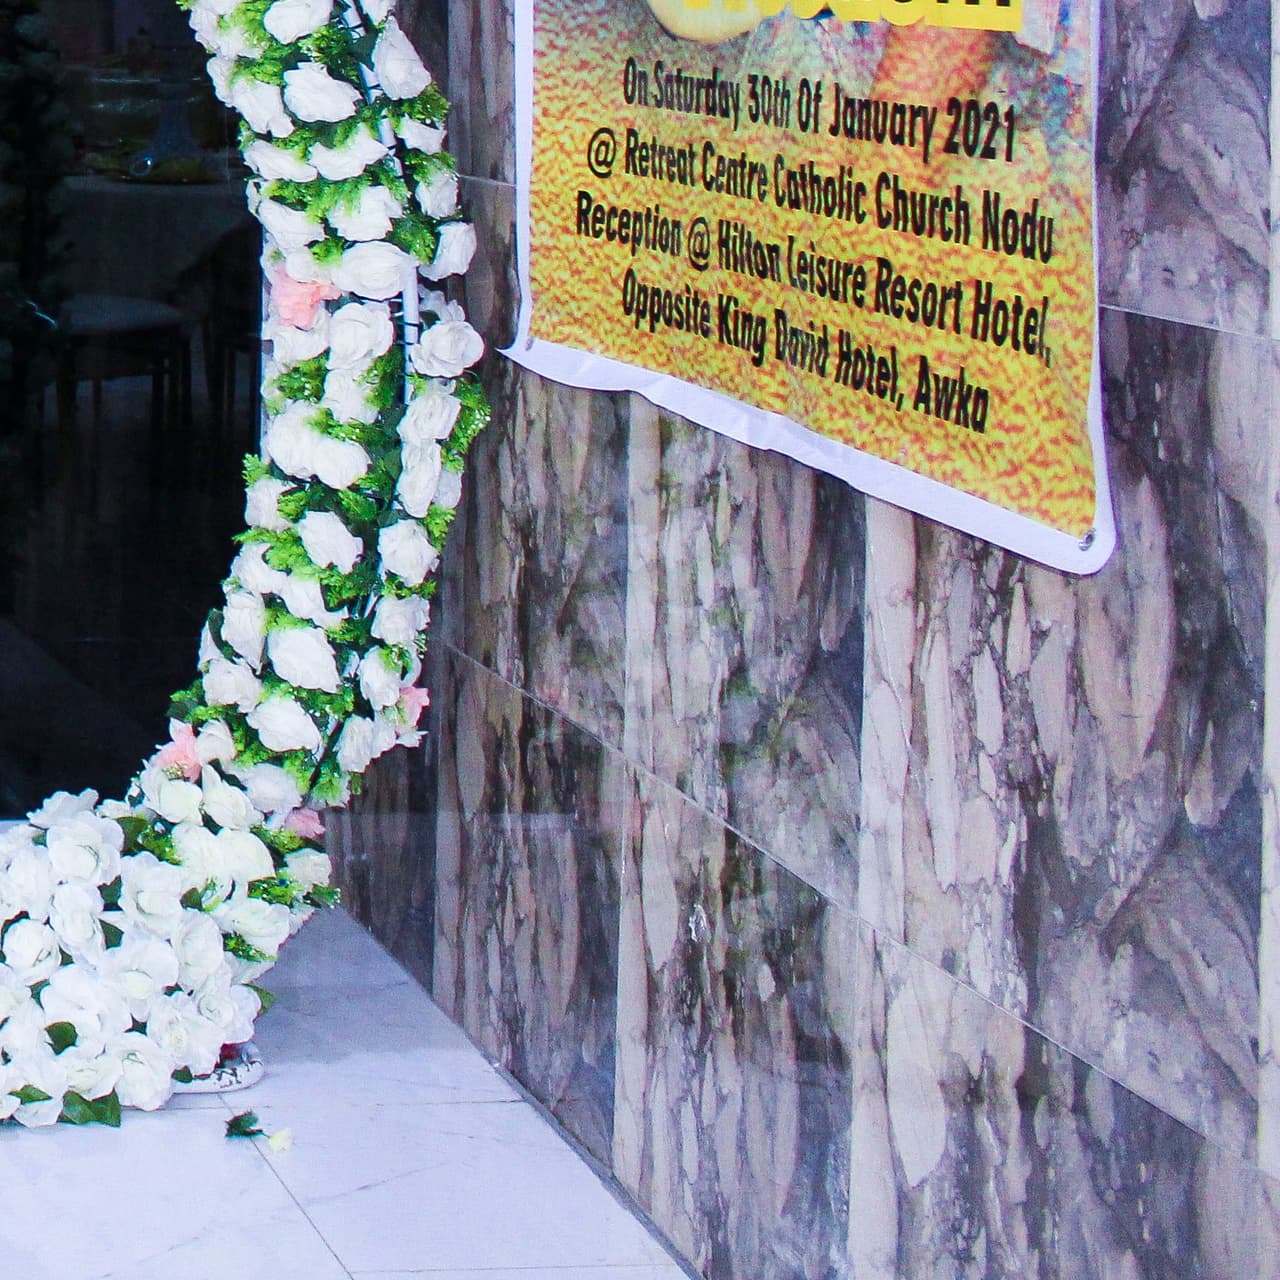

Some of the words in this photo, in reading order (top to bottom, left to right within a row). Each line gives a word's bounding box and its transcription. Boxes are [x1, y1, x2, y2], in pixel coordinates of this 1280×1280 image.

[623, 56, 649, 107] On
[653, 60, 741, 132] Saturday
[747, 73, 791, 129] 30th
[797, 77, 823, 135] Of
[828, 81, 938, 164] January
[943, 96, 1015, 163] 2021
[587, 126, 617, 179] @
[624, 127, 697, 188] Retreat
[702, 140, 768, 203] Centre
[773, 153, 867, 225] Catholic
[874, 171, 971, 246] Church
[981, 189, 1054, 265] Nodu
[576, 189, 683, 257] Reception
[688, 216, 711, 272] @
[718, 219, 782, 283] Hilton
[787, 235, 867, 309] Leisure
[873, 256, 964, 335] Resort
[970, 279, 1053, 369] Hotel,
[621, 268, 712, 339] Opposite
[717, 293, 767, 368] King
[774, 307, 830, 378] David
[834, 328, 905, 412] Hotel,
[912, 354, 990, 434] Awka
